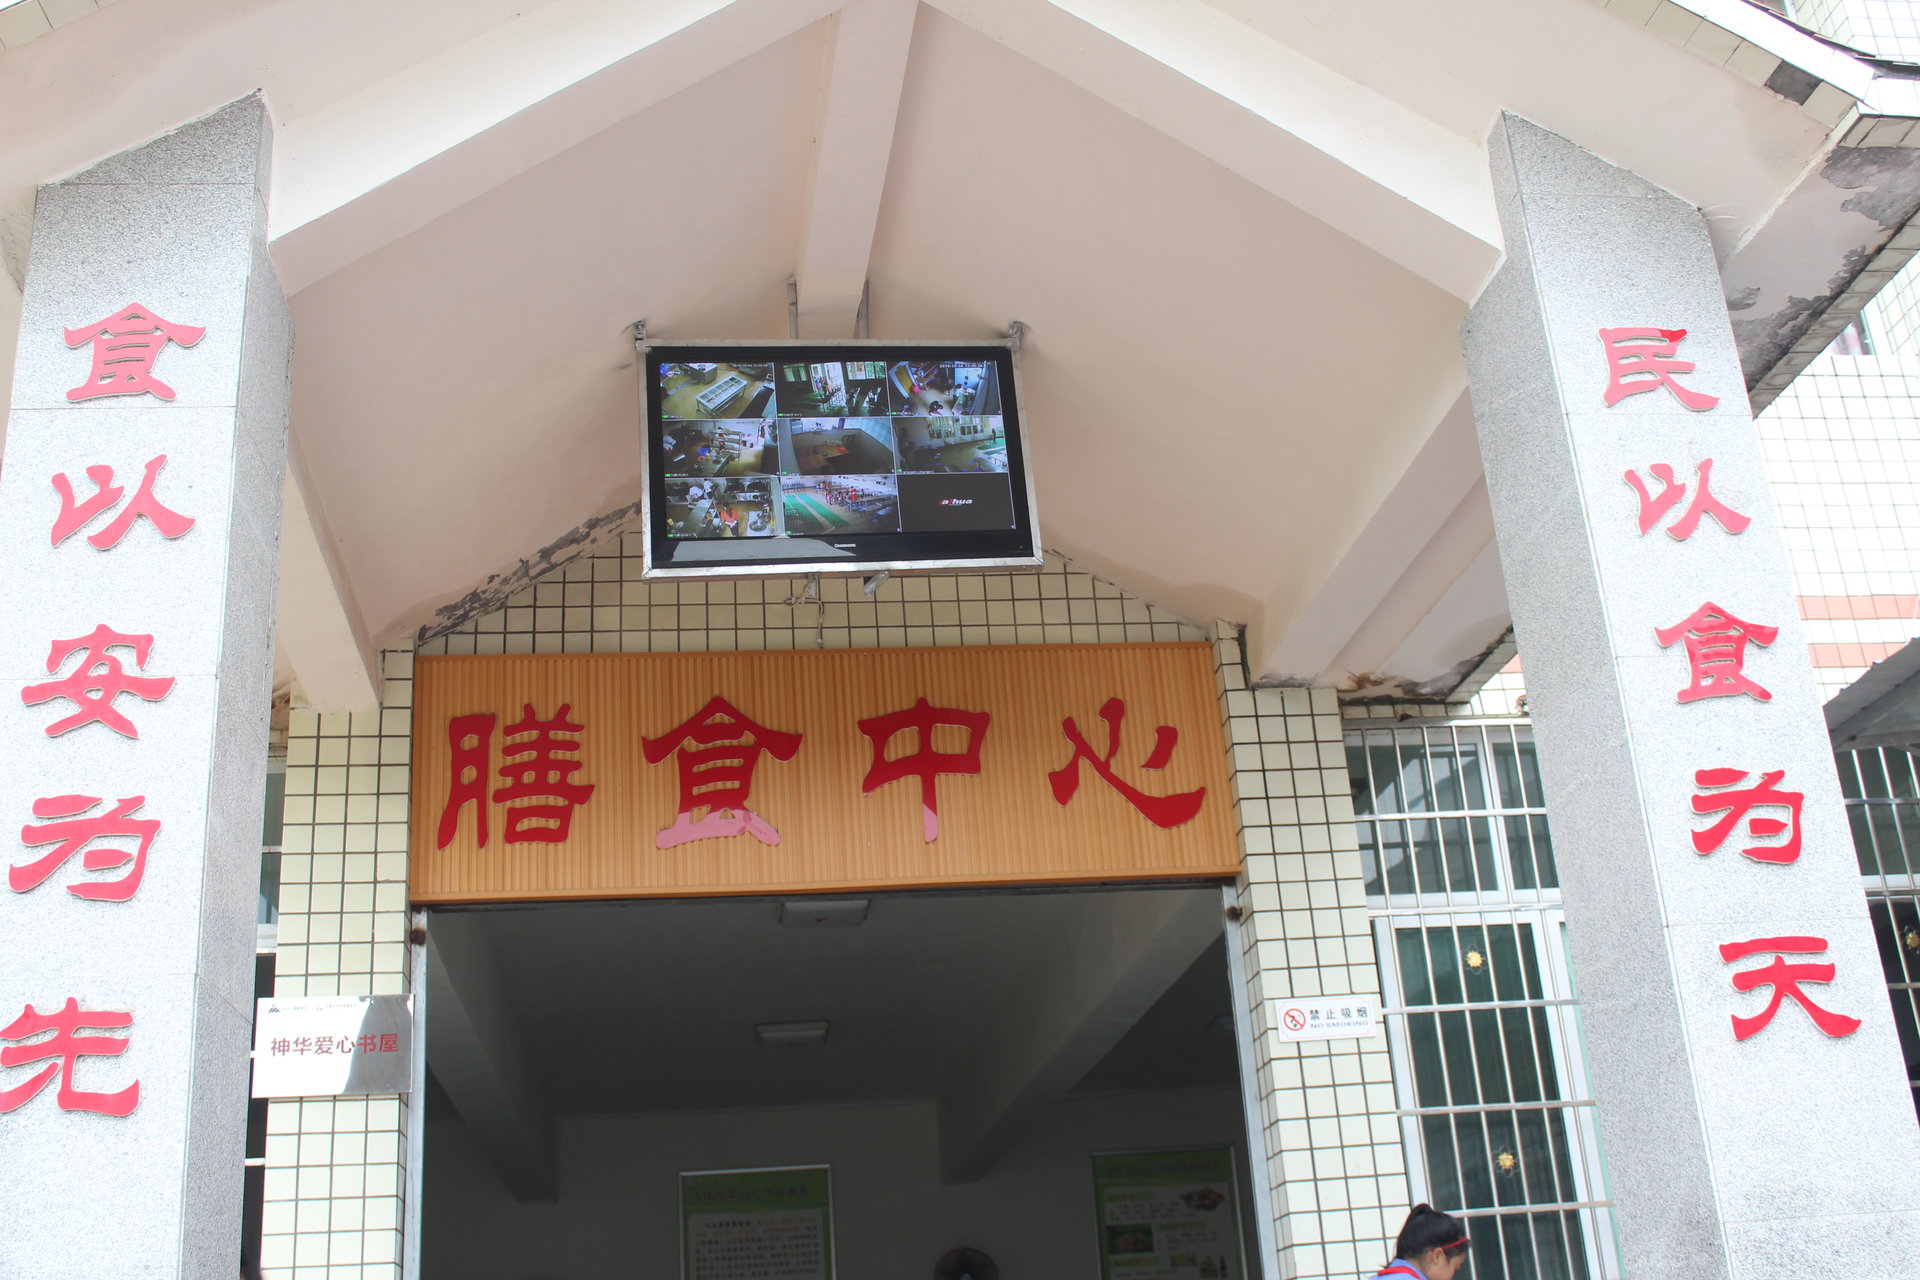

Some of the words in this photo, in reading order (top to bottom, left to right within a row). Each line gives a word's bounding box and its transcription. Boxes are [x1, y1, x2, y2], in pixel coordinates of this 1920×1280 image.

[0, 302, 207, 1118] 食以安为先
[1598, 327, 1862, 1042] 民以食为天
[436, 695, 1207, 851] 膳食中心
[270, 1033, 399, 1057] 神华爱心书屋
[1309, 1006, 1368, 1021] 禁止吸烟
[1326, 1020, 1369, 1028] SMOKING
